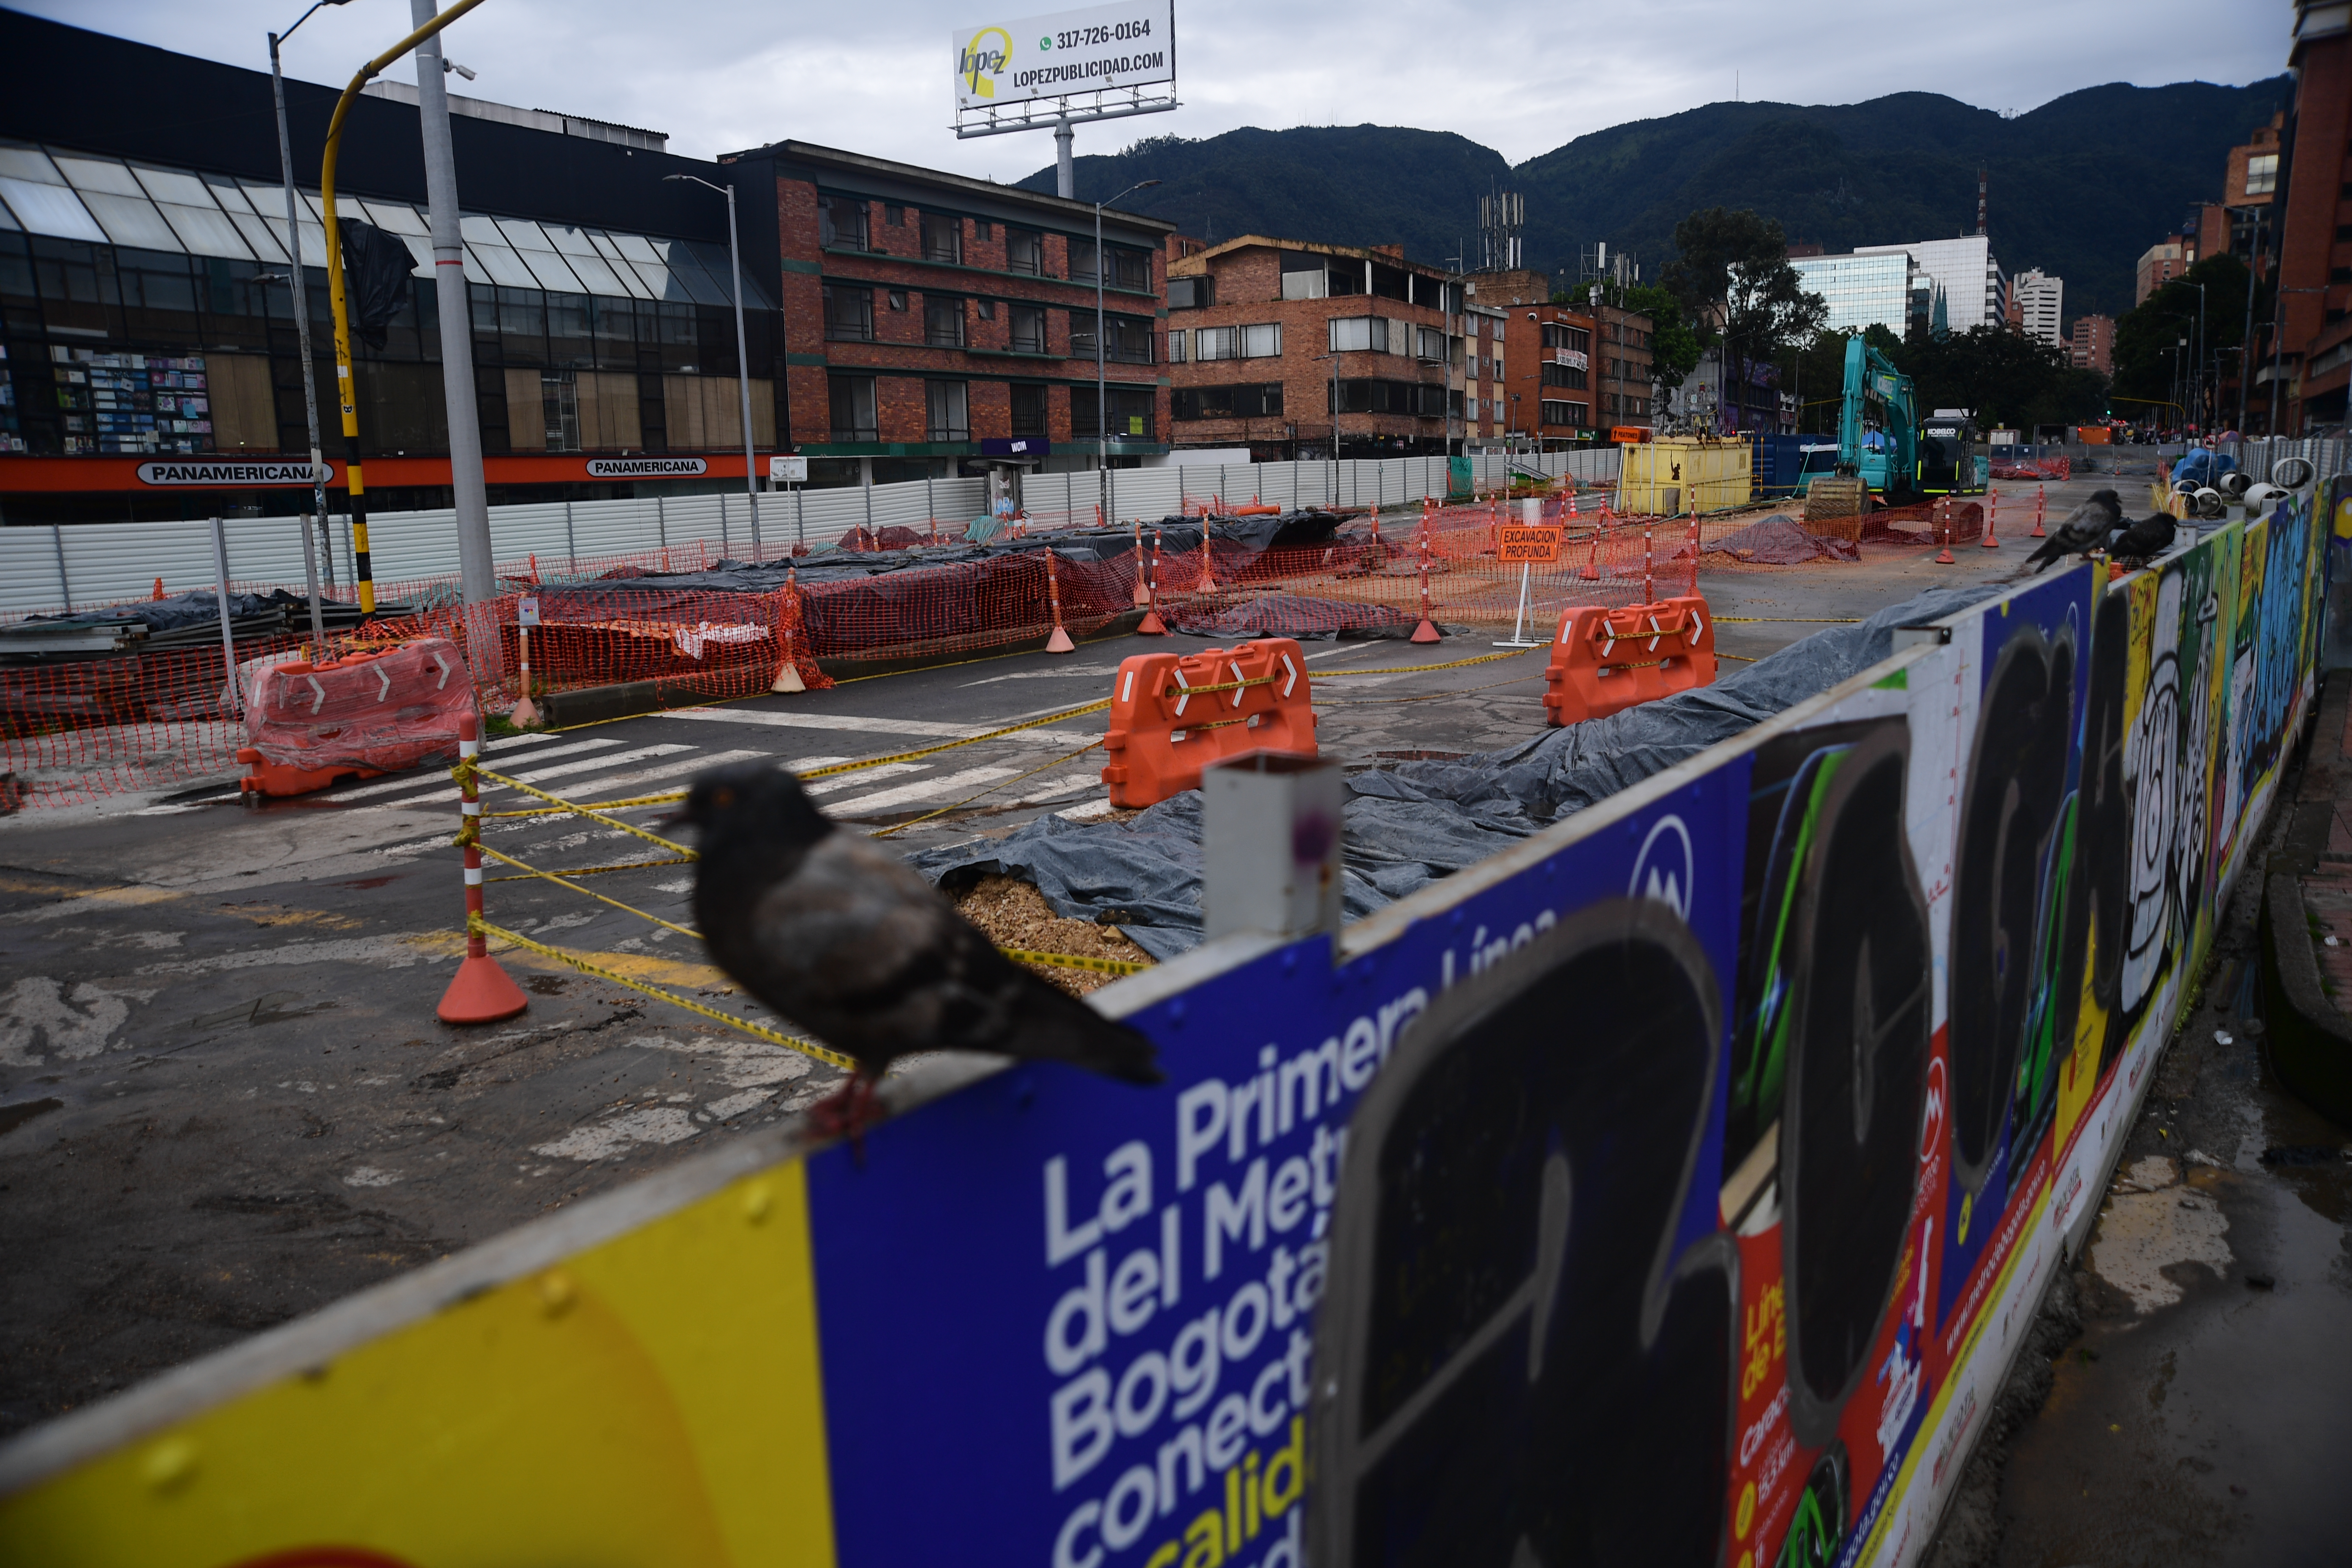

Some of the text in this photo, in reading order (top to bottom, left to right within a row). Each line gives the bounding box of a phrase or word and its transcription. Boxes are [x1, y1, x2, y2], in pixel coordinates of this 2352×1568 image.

[1057, 19, 1151, 49] 317-726-0164
[1014, 52, 1163, 87] LOPEZPUBLICIDAD.COM
[1011, 441, 1027, 453] WOM
[1618, 431, 1638, 439] PEATONES
[596, 461, 699, 473] PANAMERICANA
[1504, 531, 1556, 543] EXCAVACION
[1505, 545, 1550, 558] PROFUNDA
[1044, 1140, 1152, 1266] La
[1946, 1158, 2046, 1357] www.metrodebogota.gov.co
[1045, 1204, 1180, 1376] del
[1051, 1210, 1331, 1492] Bogotá
